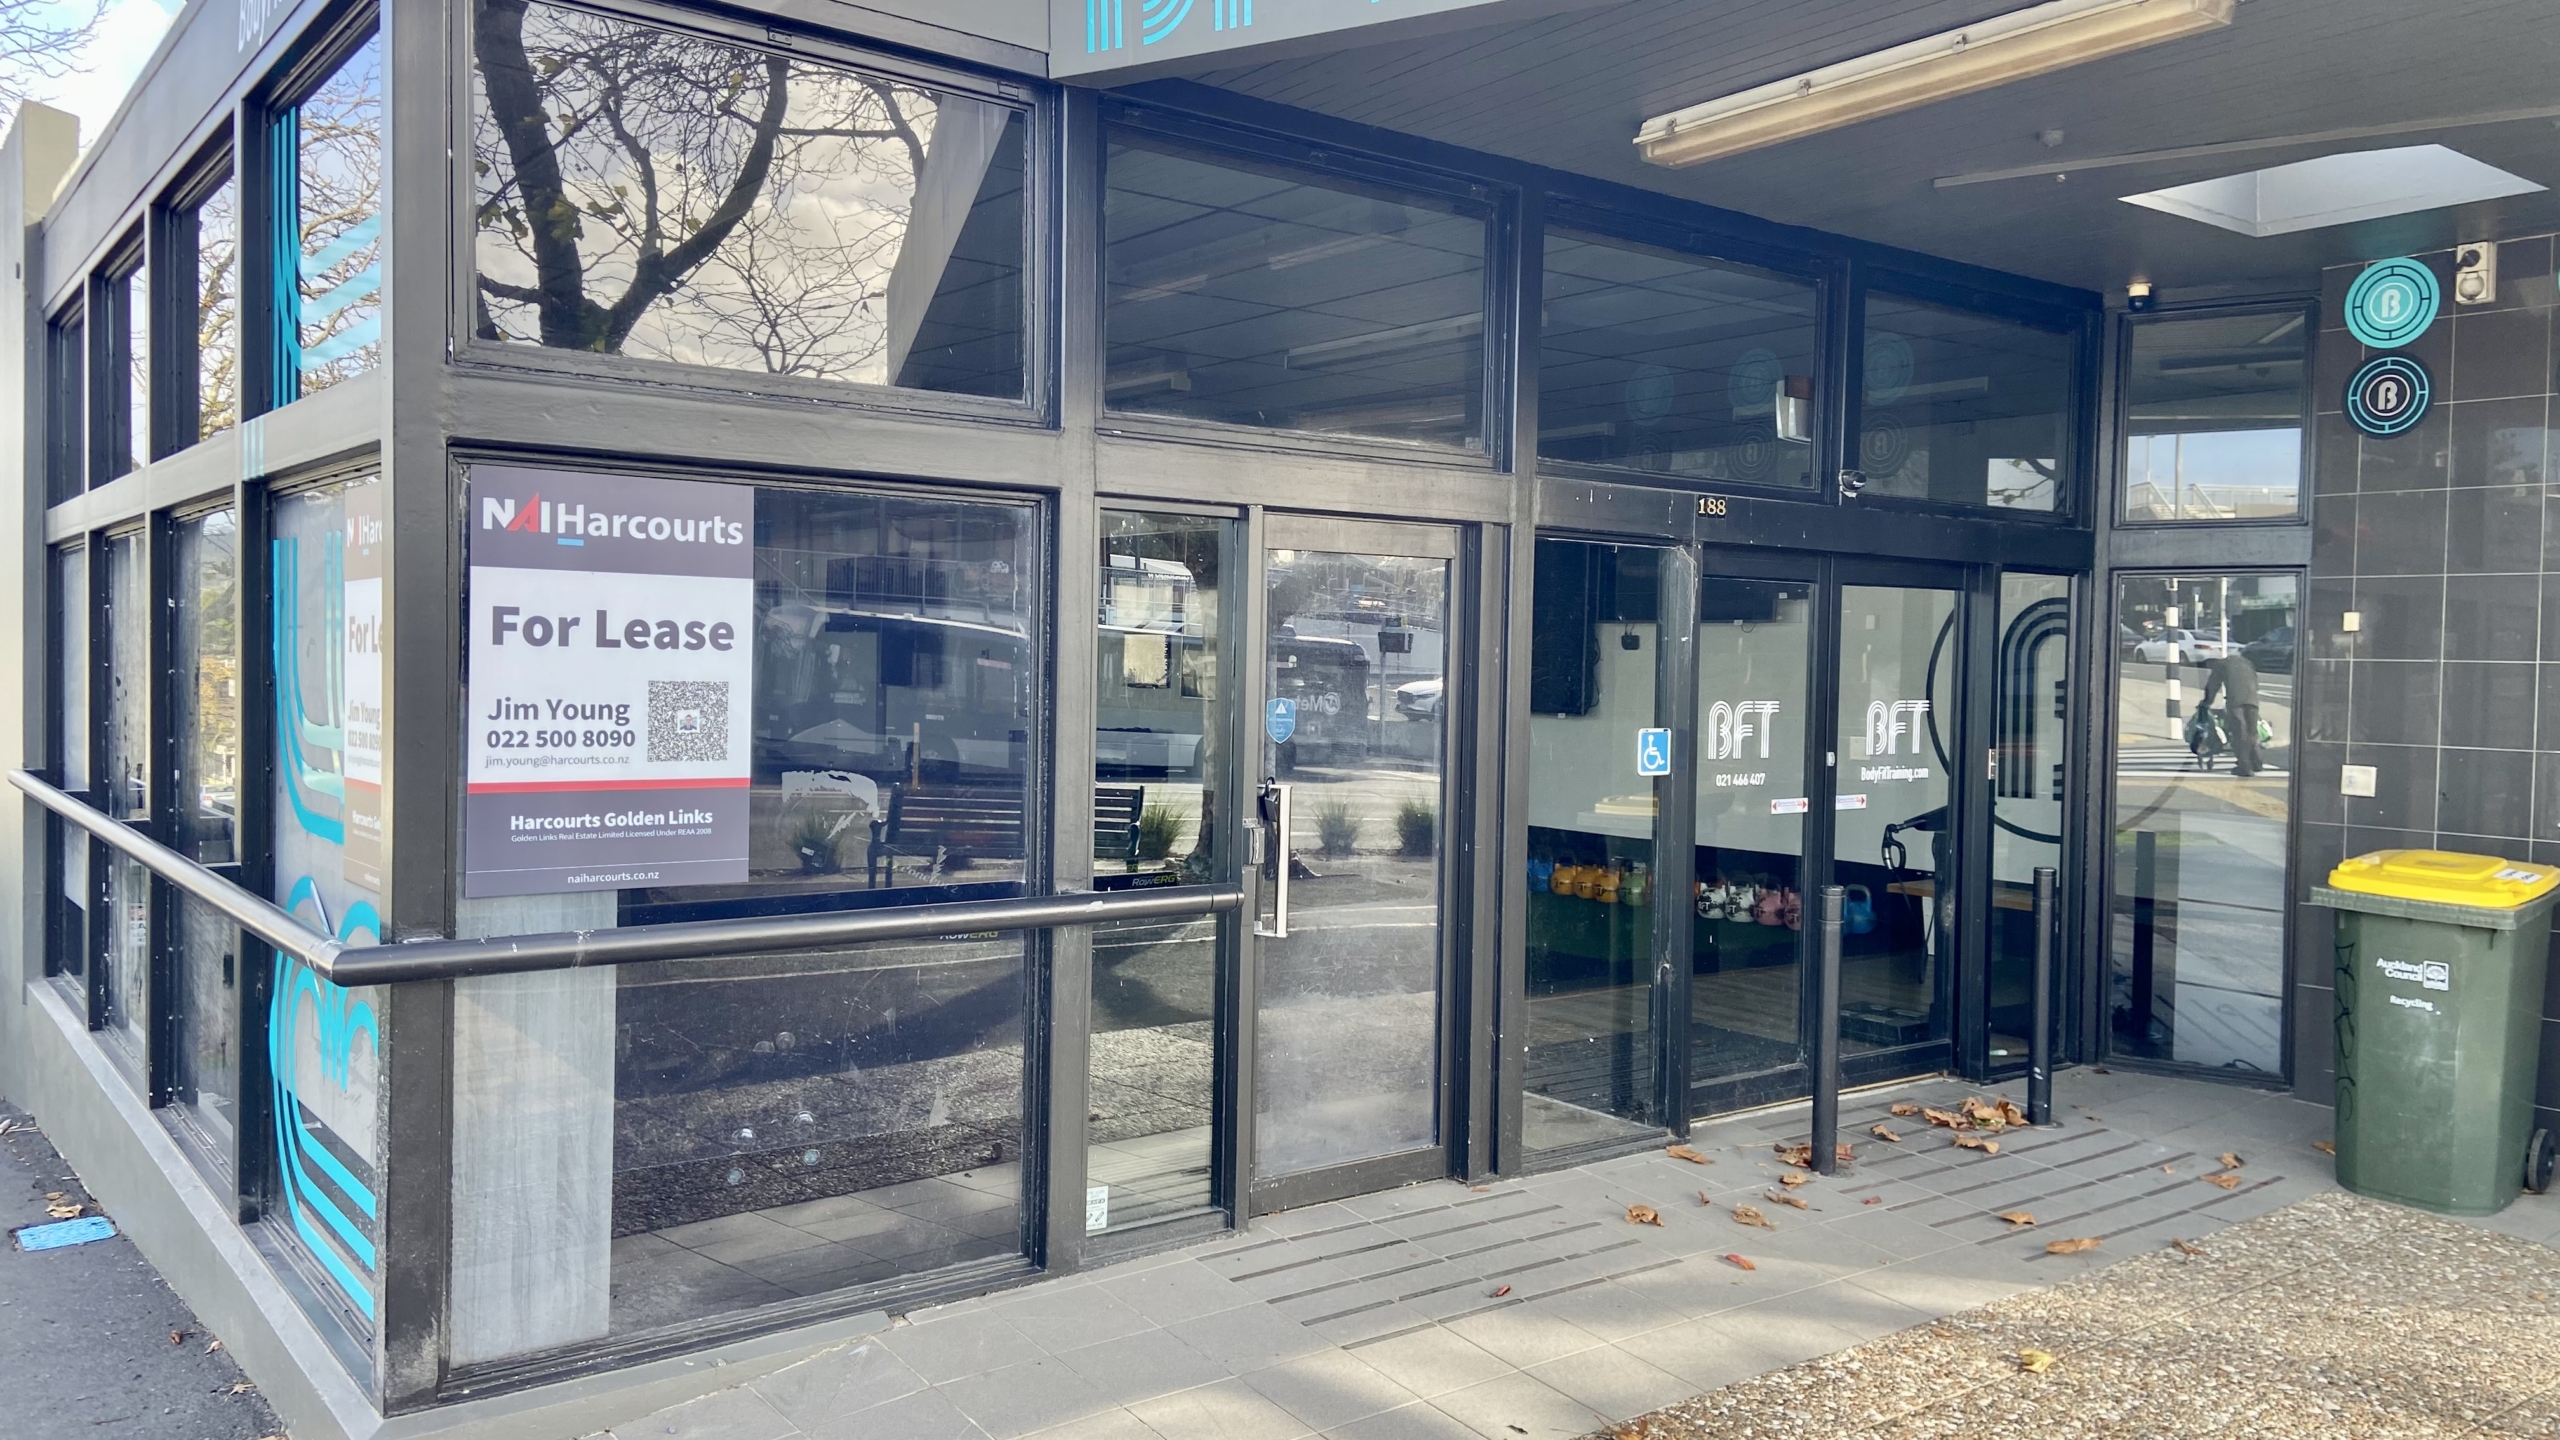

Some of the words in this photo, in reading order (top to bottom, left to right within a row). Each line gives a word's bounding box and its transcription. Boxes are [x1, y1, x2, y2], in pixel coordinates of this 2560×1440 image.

[238, 0, 282, 53] Body
[1698, 498, 1727, 515] 188
[482, 492, 551, 533] NAI
[557, 503, 744, 545] Harcourts
[349, 616, 369, 653] For
[492, 605, 581, 647] For
[596, 609, 735, 651] Lease
[487, 696, 539, 721] Jim
[545, 698, 631, 726] Young
[1708, 700, 1780, 760] BFT
[1866, 700, 1930, 755] BFT
[487, 730, 530, 748] 022
[535, 730, 577, 748] 500
[582, 729, 636, 747] 8090
[485, 755, 630, 769] jim.young@harcourts.co.nz
[1716, 774, 1731, 786] 021
[1733, 774, 1748, 786] 466
[1750, 773, 1766, 785] 407
[1861, 765, 1929, 784] BodyFitTraining.com
[510, 815, 601, 831] Harcourts
[604, 810, 665, 827] Golden
[669, 809, 714, 825] Links
[511, 834, 538, 843] Golden
[539, 833, 558, 842] Links
[559, 832, 575, 840] Real
[575, 832, 597, 840] Estate
[598, 831, 625, 839] Limited
[626, 829, 655, 838] Licensed
[656, 829, 677, 837] Under
[678, 828, 695, 836] REAA
[567, 870, 659, 884] naiharcourts.co.nz
[1132, 874, 1176, 887] RowERG
[2376, 957, 2424, 973] Auckland
[2385, 968, 2424, 982] Council
[2389, 995, 2434, 1011] Recycling
